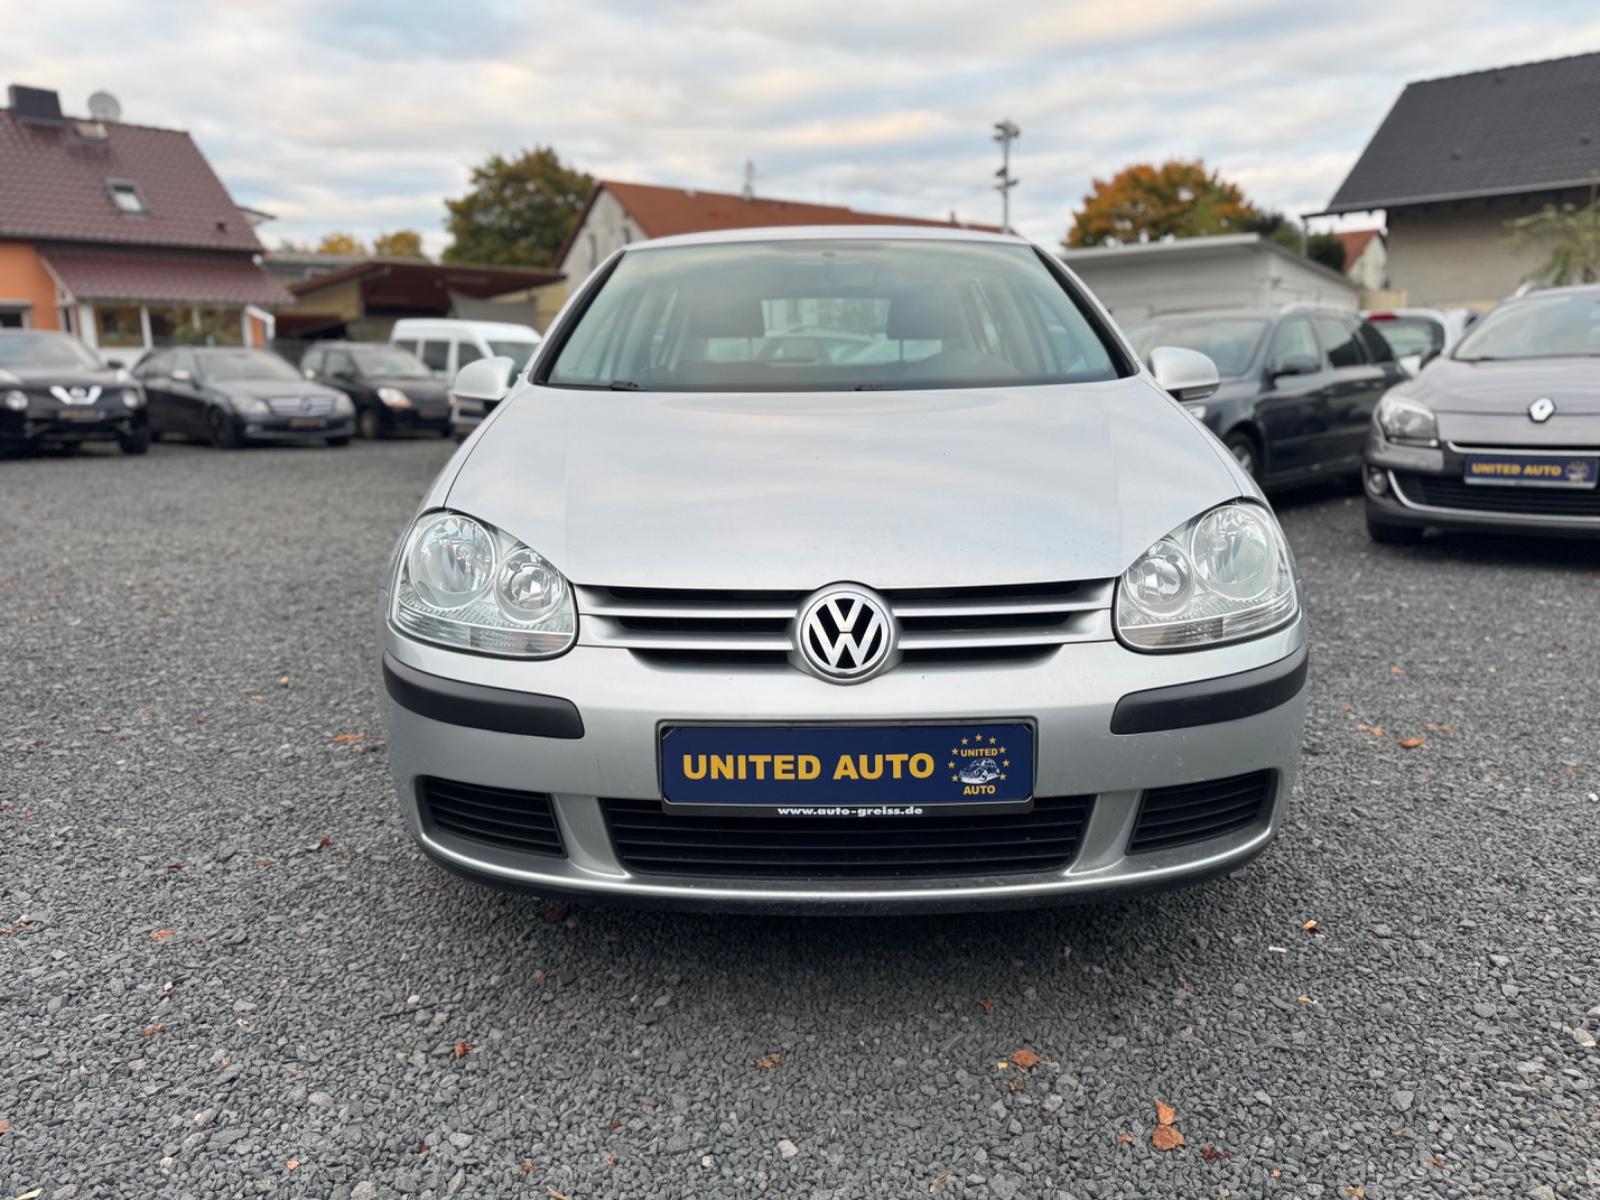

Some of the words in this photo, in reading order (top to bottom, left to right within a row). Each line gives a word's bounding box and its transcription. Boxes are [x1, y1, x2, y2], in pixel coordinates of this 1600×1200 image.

[1471, 463, 1521, 475] UNITED
[1523, 464, 1562, 476] AUTO
[960, 748, 998, 757] UNITED
[683, 754, 821, 780] UNITED
[832, 753, 935, 780] AUTO
[963, 784, 996, 795] AUTO
[777, 806, 923, 817] www.auto-greiss.de
